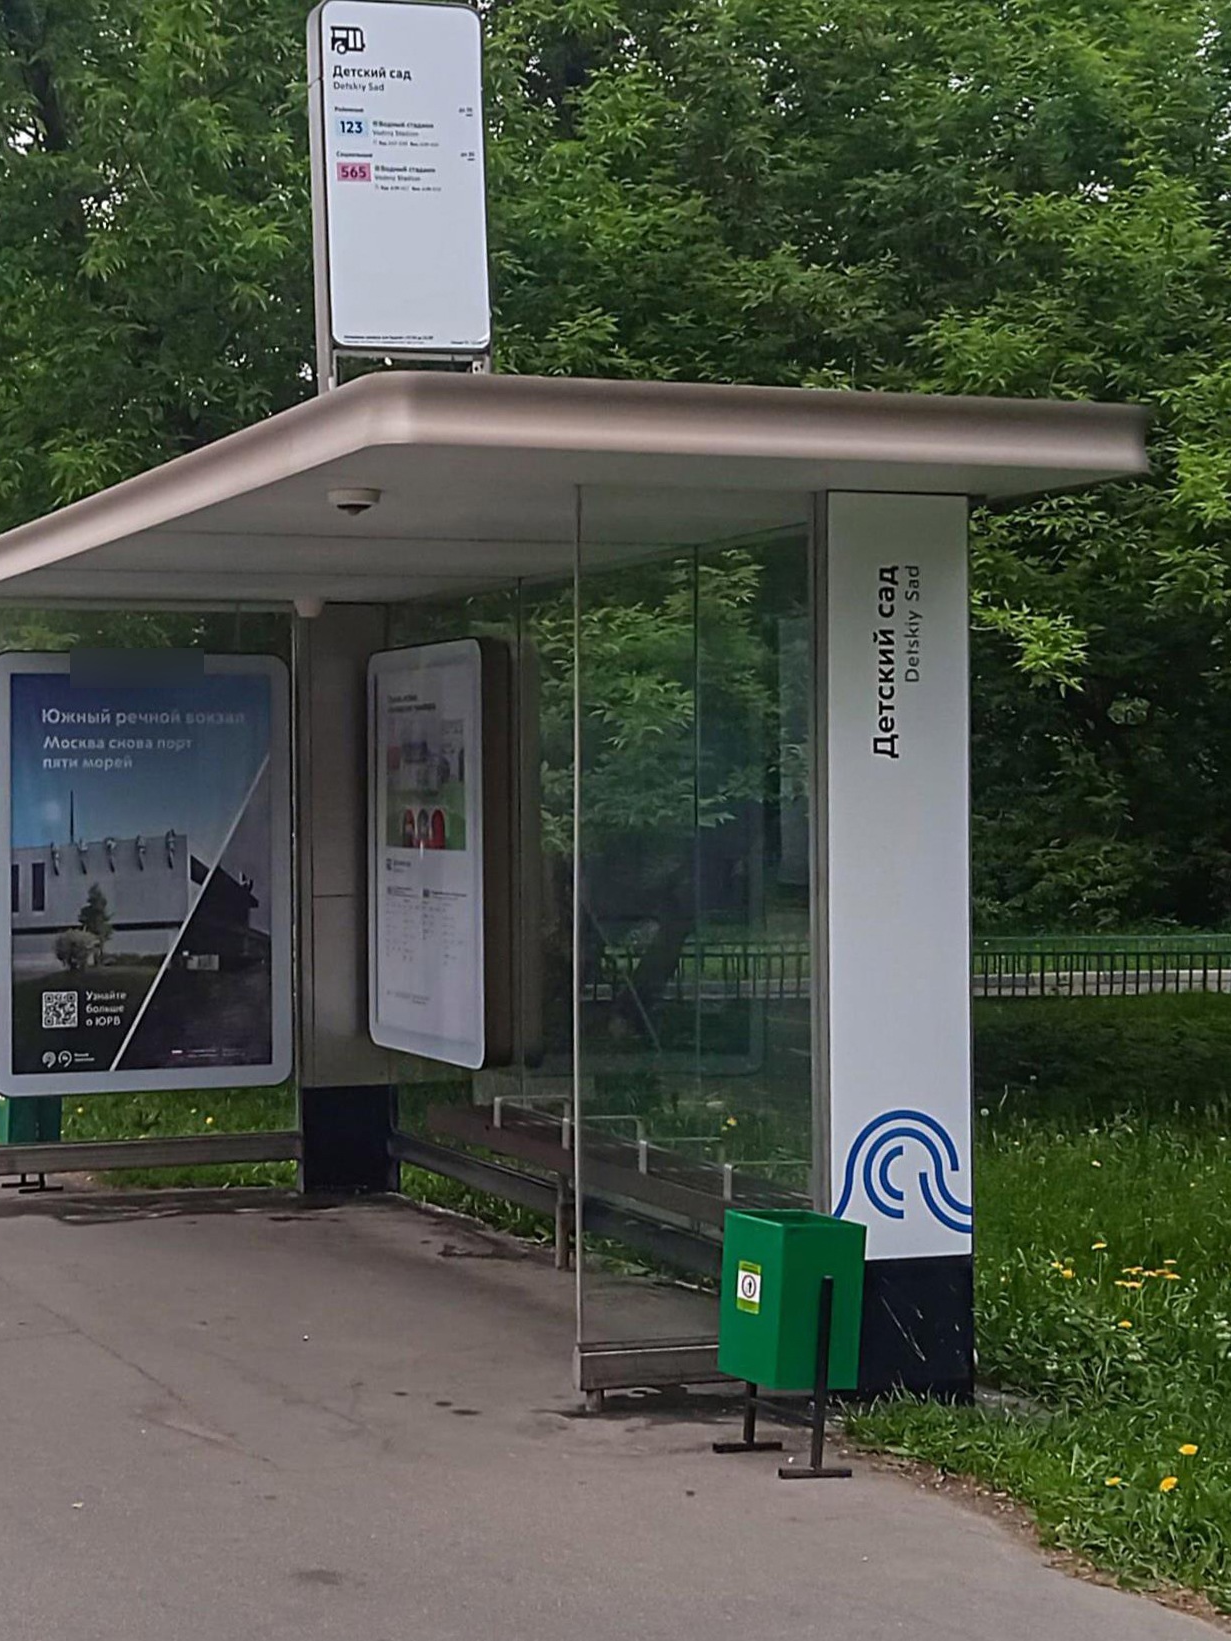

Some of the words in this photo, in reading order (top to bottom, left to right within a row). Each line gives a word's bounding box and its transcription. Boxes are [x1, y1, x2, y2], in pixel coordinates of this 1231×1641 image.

[332, 65, 386, 79] Детский
[389, 69, 412, 81] сад
[333, 81, 366, 92] Detskiy
[368, 82, 385, 91] Sad
[340, 120, 363, 134] 123
[341, 165, 367, 179] 565
[904, 565, 919, 601] Sad
[878, 565, 899, 618] сад
[904, 610, 923, 683] Detskiy
[873, 629, 899, 759] Детский
[42, 708, 111, 724] Южный
[116, 709, 181, 727] речной
[185, 712, 245, 725] вокзал
[43, 736, 104, 749] Москва
[108, 738, 153, 750] снова
[157, 738, 193, 751] порт
[43, 757, 78, 769] пяти
[82, 755, 133, 771] морей
[86, 990, 127, 1001] Узнайте
[86, 1003, 125, 1013] больше
[86, 1018, 93, 1026] о
[95, 1015, 121, 1026] ЮРВ
